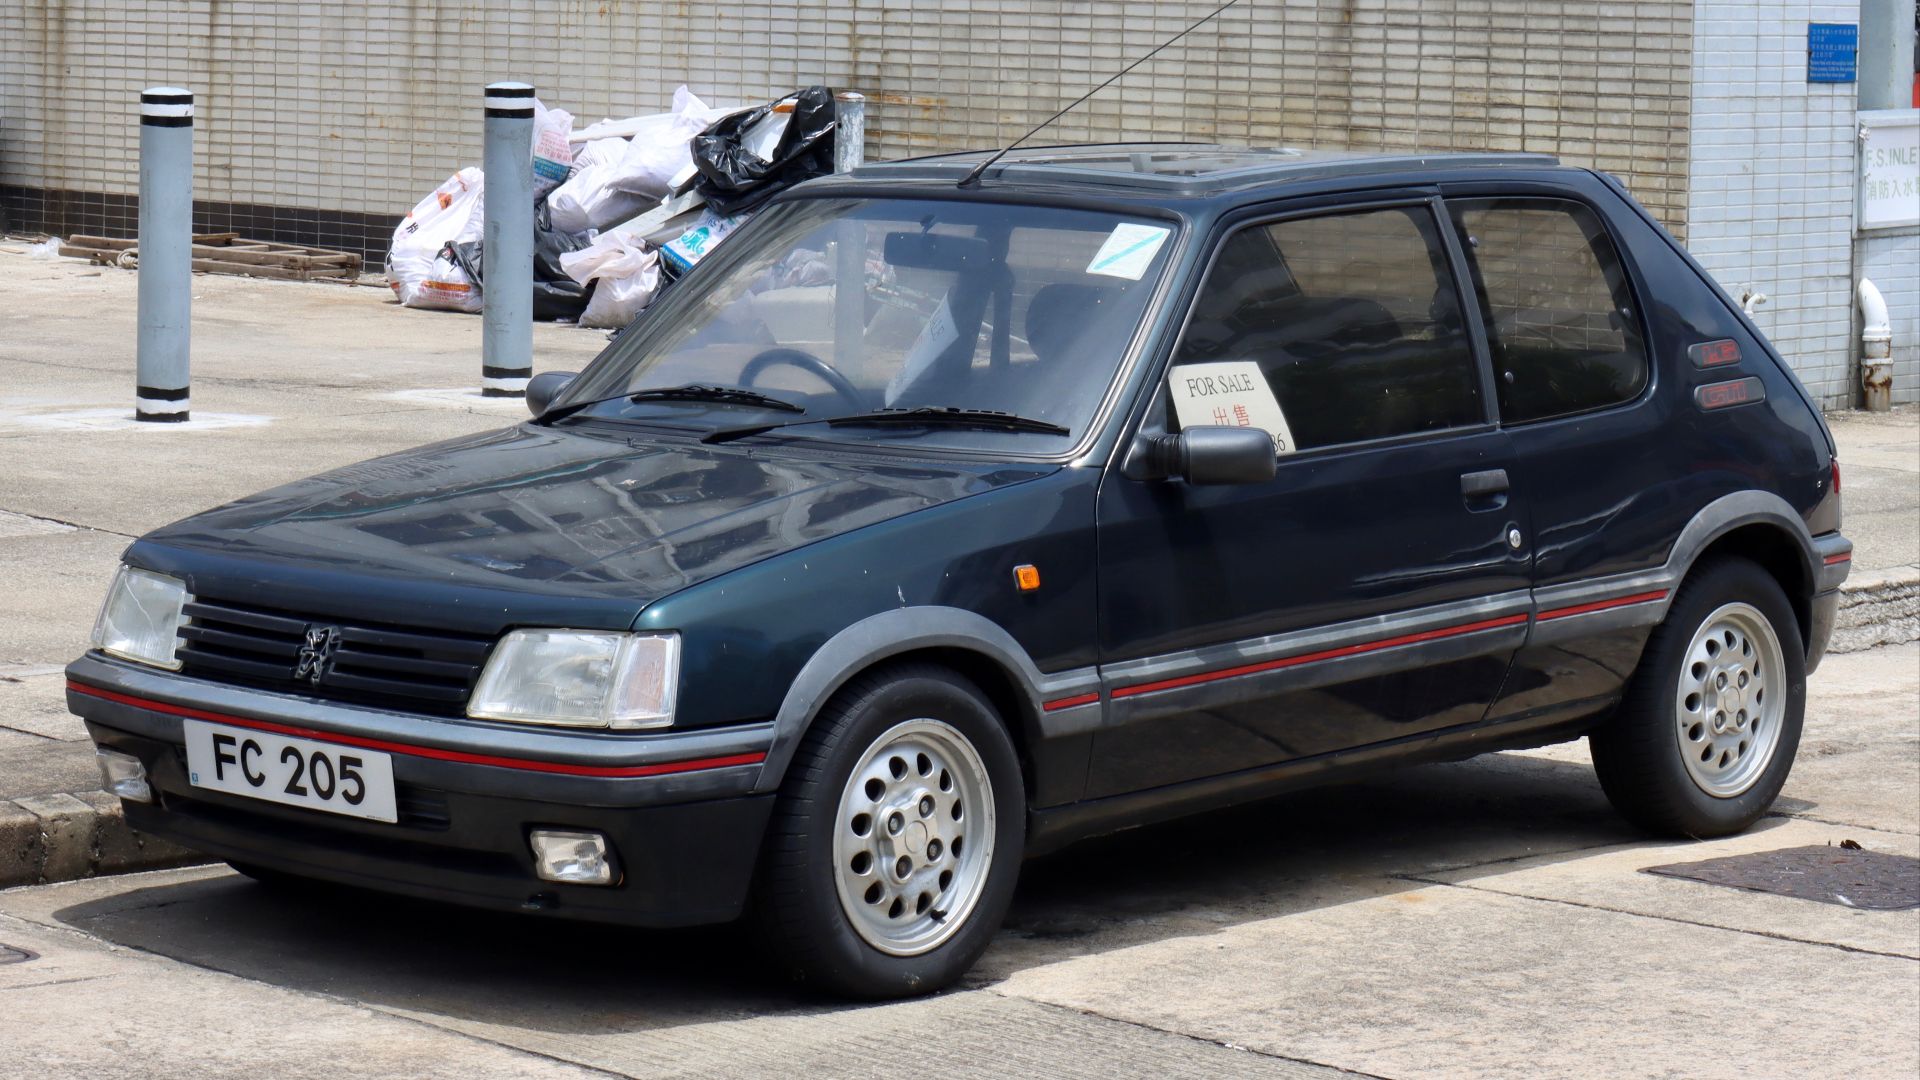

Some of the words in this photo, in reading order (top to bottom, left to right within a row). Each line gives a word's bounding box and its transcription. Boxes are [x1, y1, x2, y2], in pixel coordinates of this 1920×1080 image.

[1864, 145, 1920, 168] F.S.INLE
[1186, 377, 1218, 398] FOR
[1218, 373, 1254, 394] SALE
[1213, 403, 1250, 427] 出售
[213, 733, 266, 788] FC
[280, 746, 365, 806] 205
